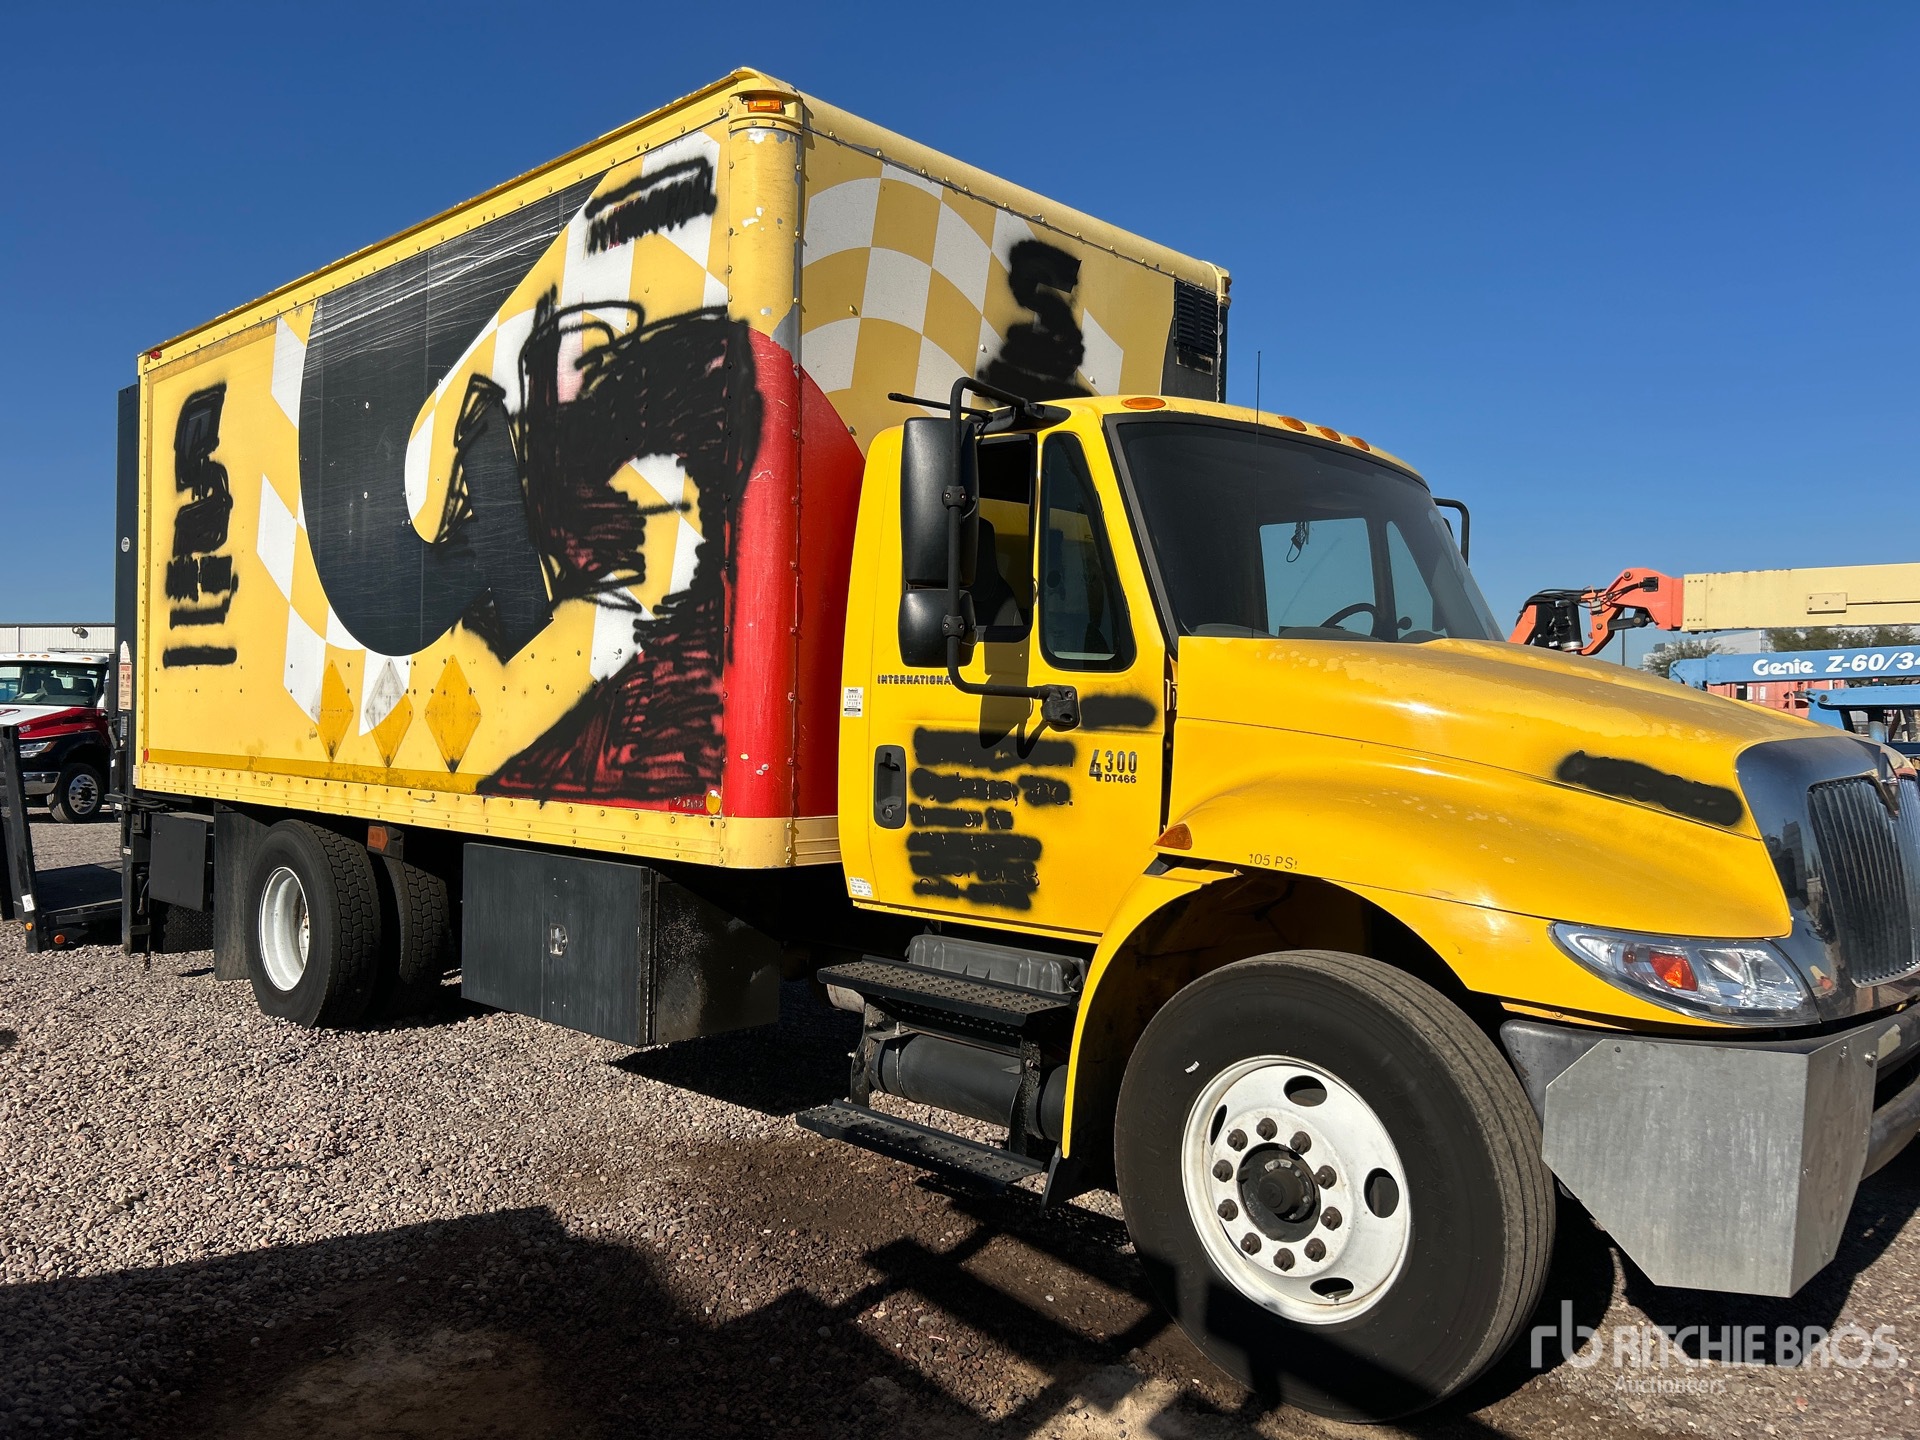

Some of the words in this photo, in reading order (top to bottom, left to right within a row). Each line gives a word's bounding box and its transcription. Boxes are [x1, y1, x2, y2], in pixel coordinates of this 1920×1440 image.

[1753, 658, 1814, 676] Genie
[877, 674, 955, 686] INTERNATIONA
[1089, 749, 1137, 782] 4300
[1104, 774, 1137, 784] DT466
[1249, 853, 1271, 866] 105
